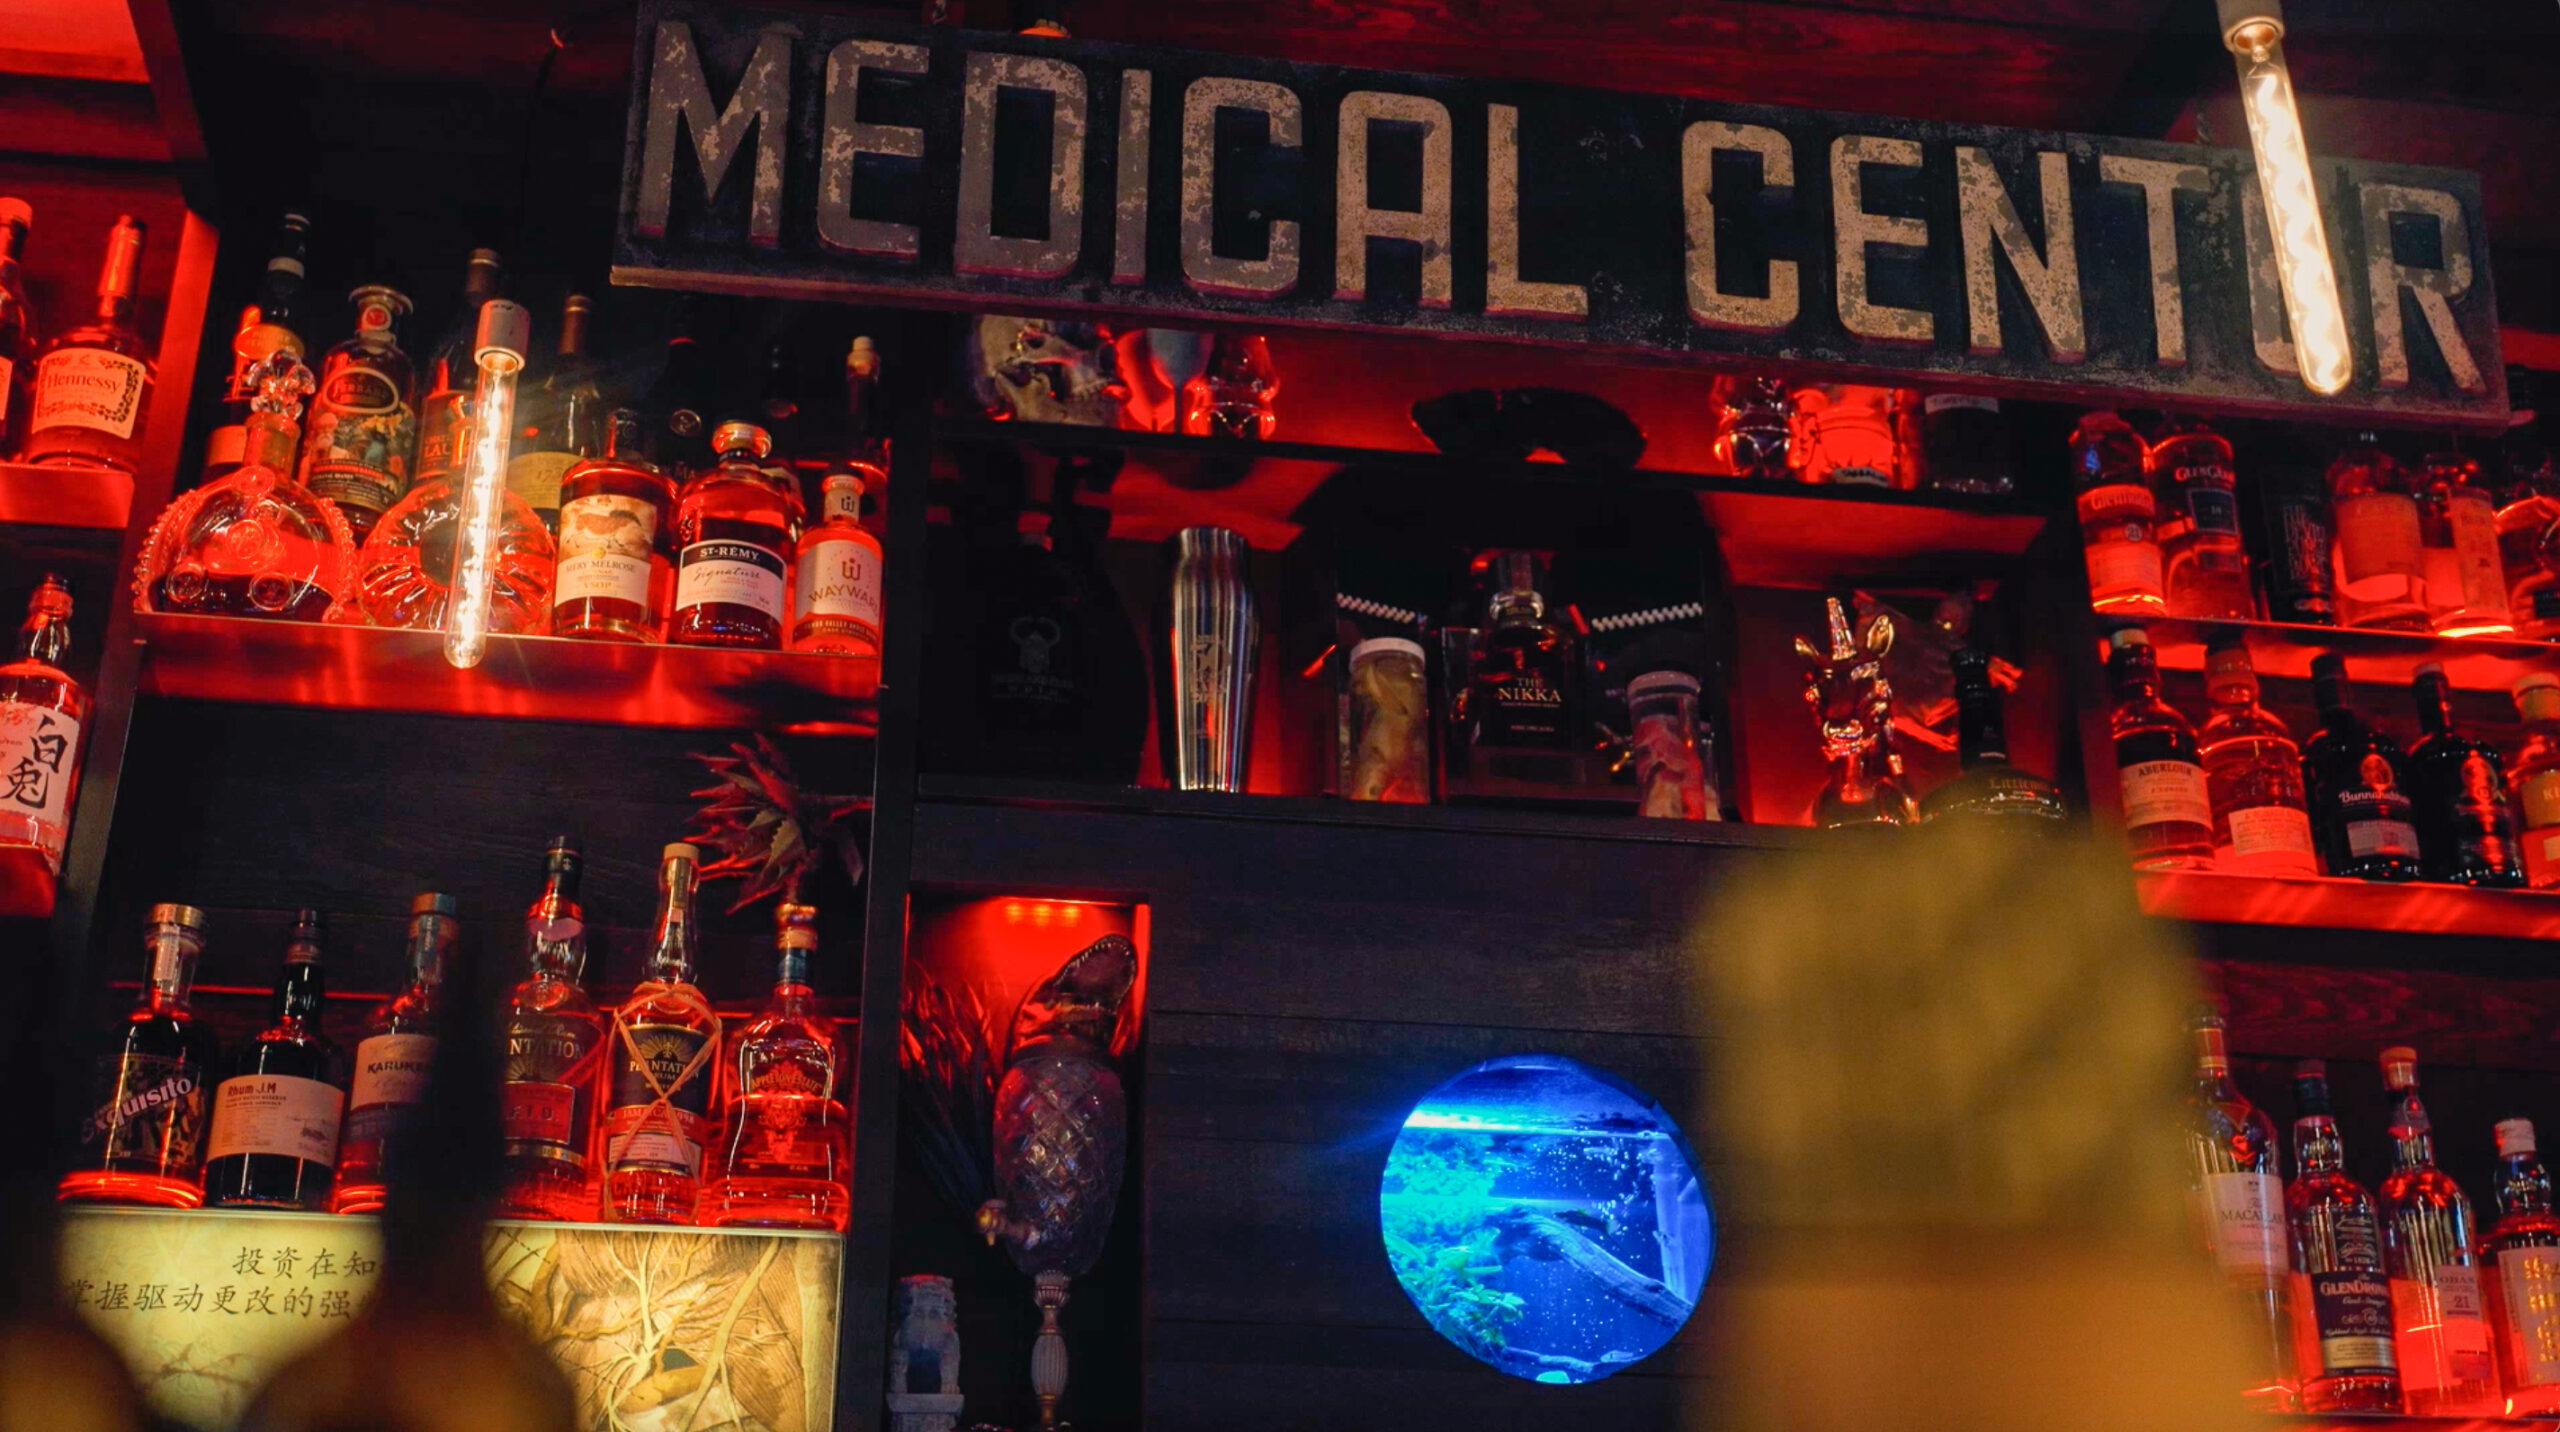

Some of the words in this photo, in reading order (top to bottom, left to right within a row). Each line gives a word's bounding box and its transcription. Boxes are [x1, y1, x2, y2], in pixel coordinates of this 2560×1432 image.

[638, 18, 1590, 322] MEDICAL
[46, 373, 121, 393] Hennessy
[1517, 677, 1544, 687] THE
[1497, 687, 1563, 703] NIKKA
[2138, 763, 2193, 777] ABERLOUR
[629, 1060, 700, 1080] PLNTATIN
[228, 1084, 254, 1097] Rhum
[232, 1245, 376, 1281] 投资在知
[2453, 1294, 2470, 1309] 21
